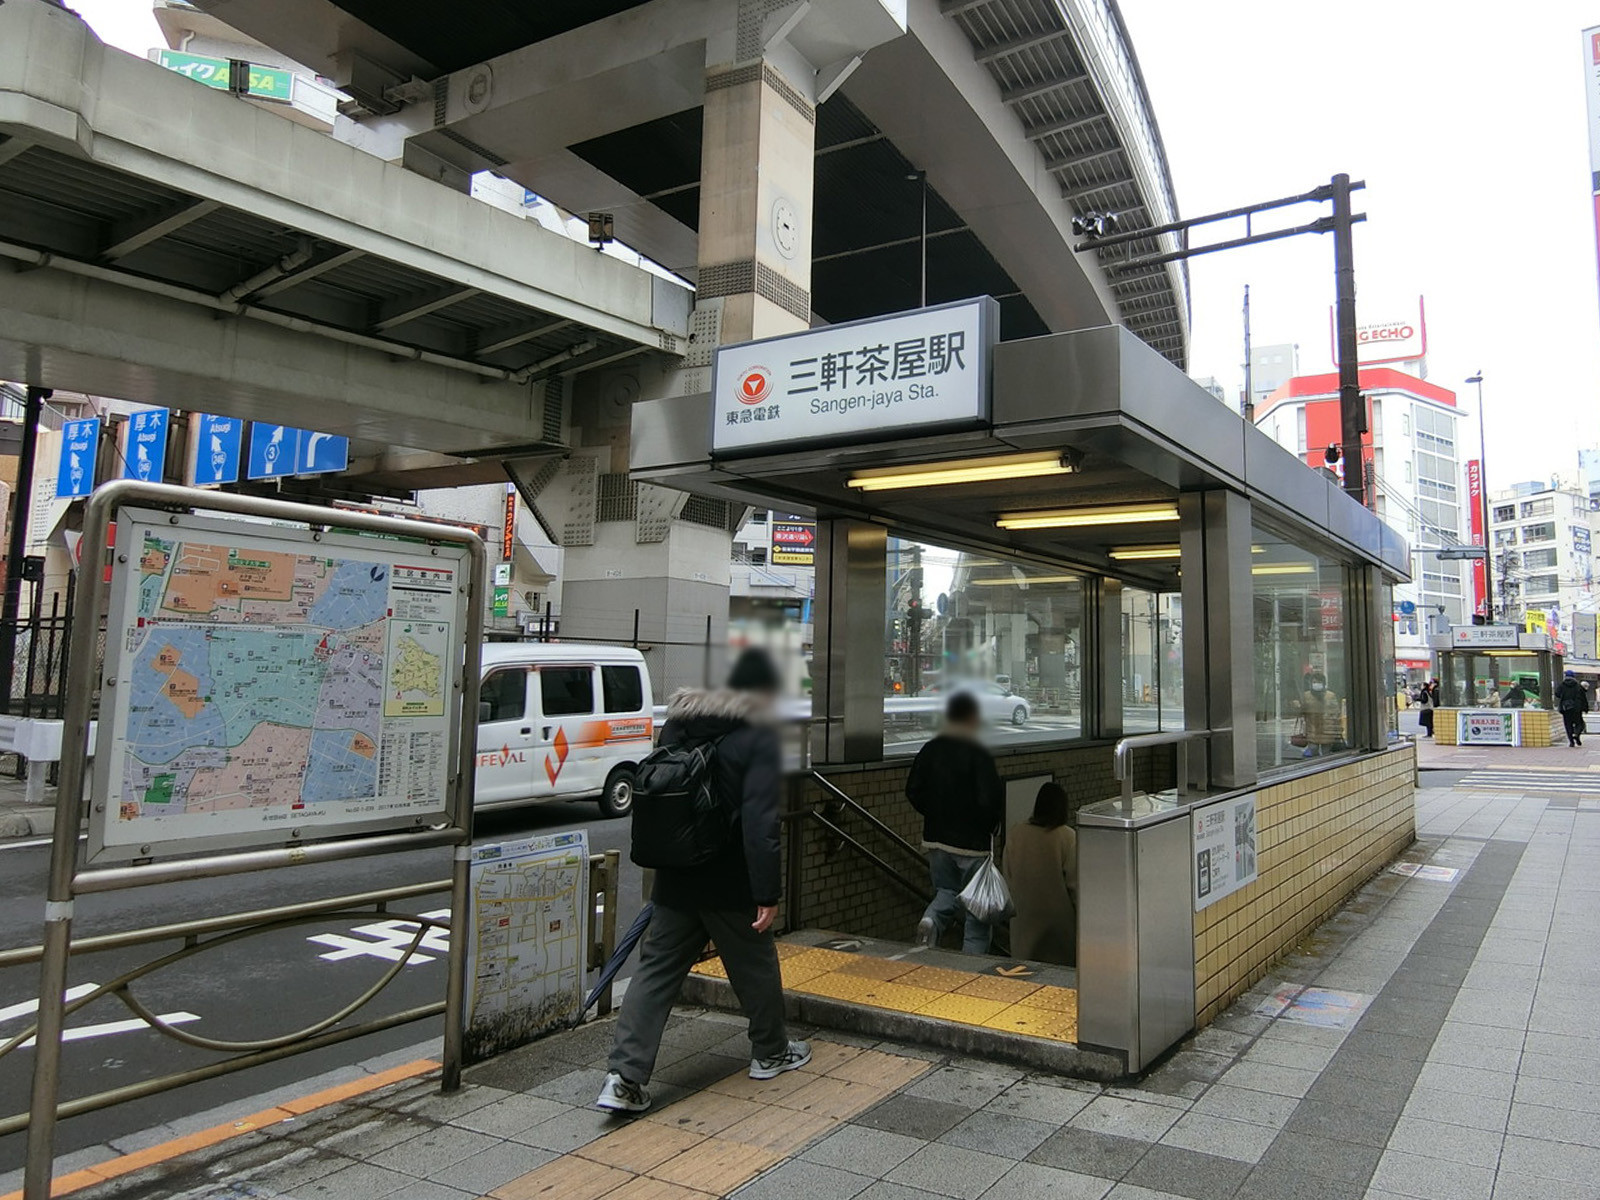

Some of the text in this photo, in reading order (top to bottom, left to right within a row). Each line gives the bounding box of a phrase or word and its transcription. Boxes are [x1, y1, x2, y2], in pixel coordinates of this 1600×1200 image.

[1372, 326, 1414, 339] ECHO
[787, 331, 966, 396] 三軒茶屋駅
[810, 383, 940, 415] Sangen-jaya Sta.
[134, 412, 162, 431] 厚木
[726, 404, 781, 426] 東急電鉄
[68, 422, 94, 440] 厚木
[210, 422, 231, 434] Atsugi
[269, 447, 275, 459] 3
[1470, 465, 1479, 497] カラオケ
[1472, 630, 1515, 639] 三軒茶屋駅
